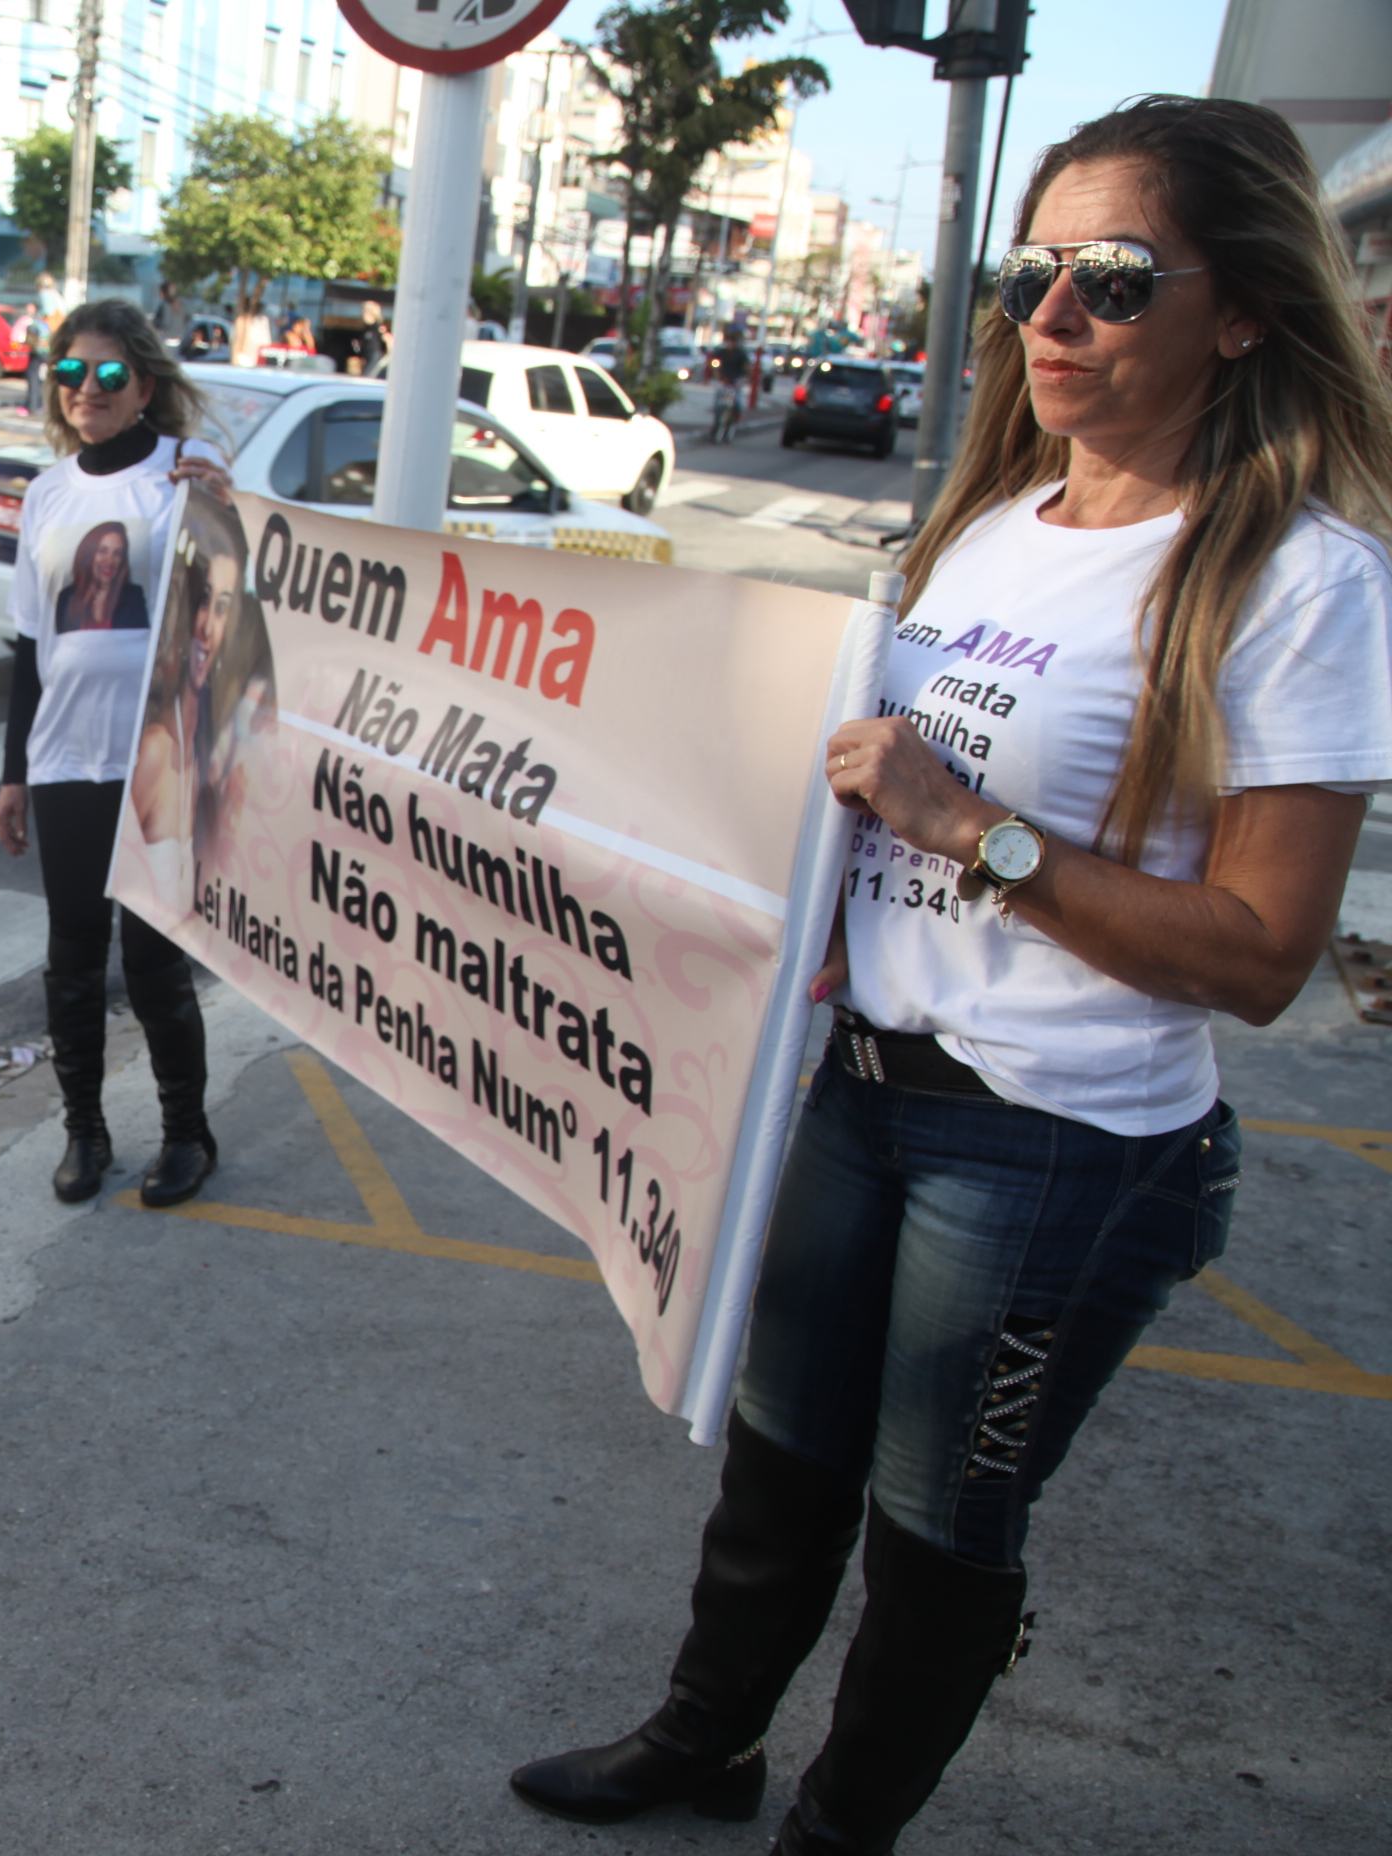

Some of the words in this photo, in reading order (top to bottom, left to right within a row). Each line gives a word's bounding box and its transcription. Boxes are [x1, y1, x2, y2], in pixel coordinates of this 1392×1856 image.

[255, 512, 406, 643] Quem
[418, 551, 595, 707] Ama
[930, 675, 1016, 719] mata
[941, 624, 1058, 677] AMA
[333, 668, 419, 757] Não
[418, 704, 557, 827] Mata
[312, 748, 394, 845] Não
[408, 792, 633, 982] humilha
[851, 833, 877, 858] Da
[890, 844, 961, 879] Penh
[311, 840, 397, 943] Não
[415, 911, 653, 1118] maltrata
[193, 860, 221, 930] Lei
[228, 886, 299, 984] Maria
[309, 941, 344, 1013] da
[355, 963, 458, 1091] Penha
[593, 1126, 681, 1317] 11.340
